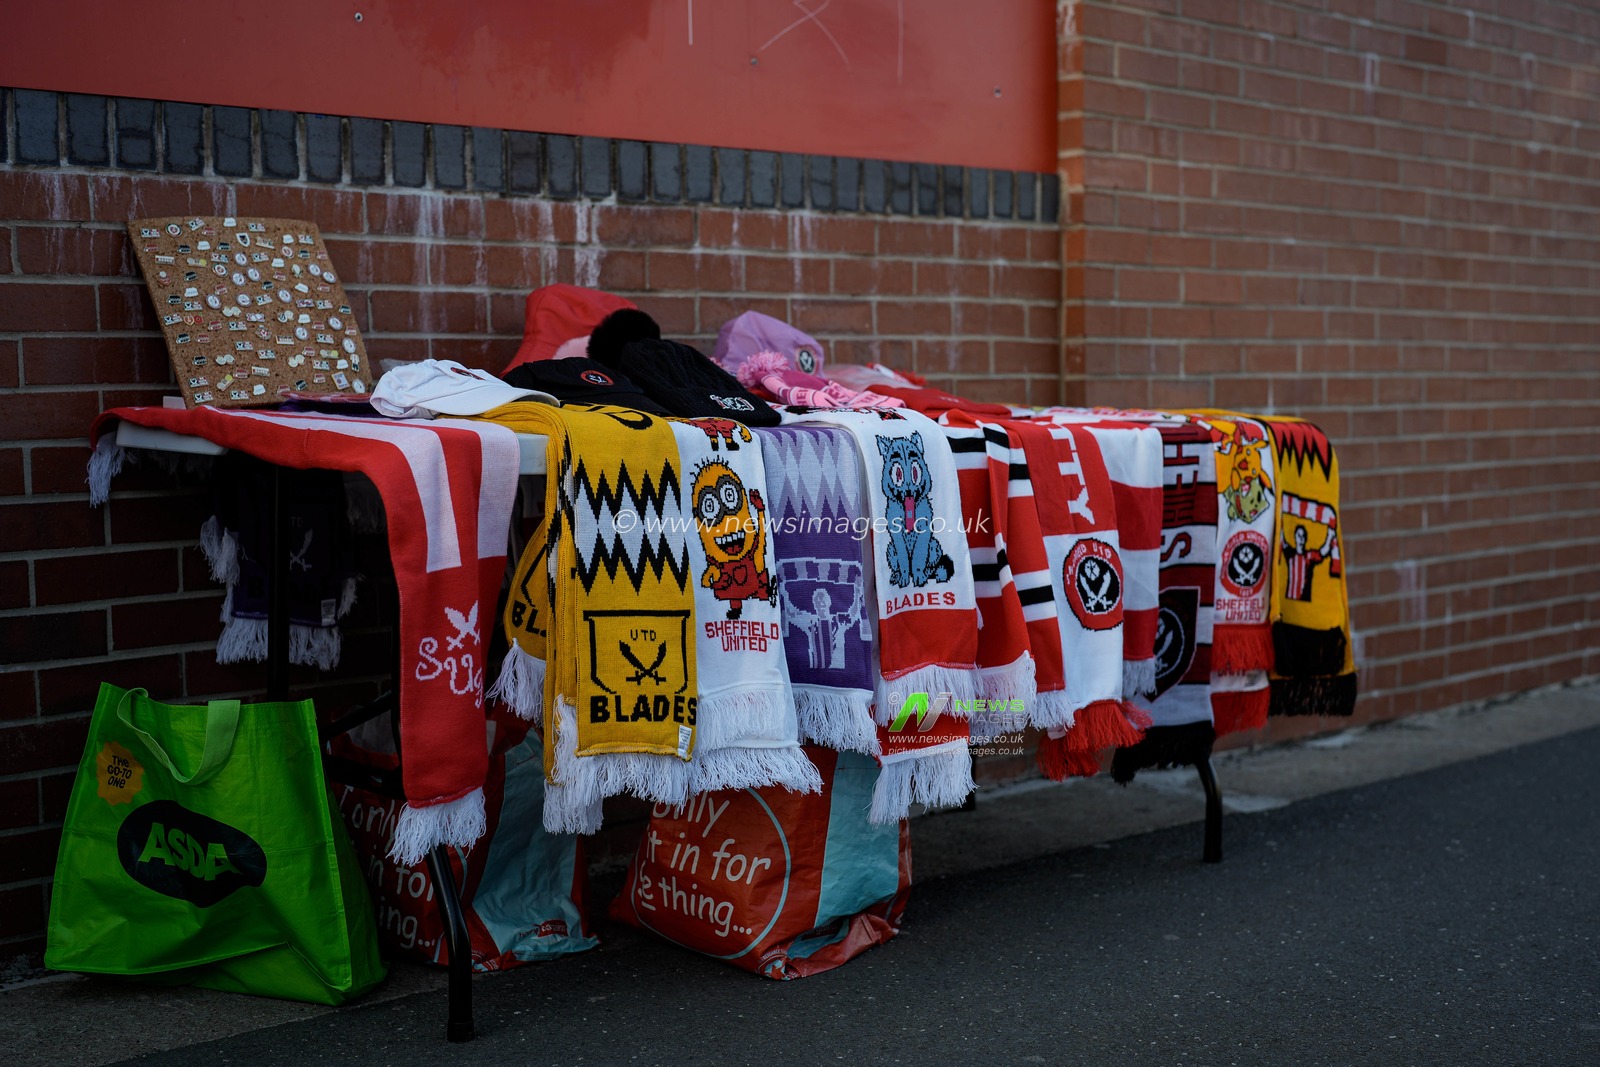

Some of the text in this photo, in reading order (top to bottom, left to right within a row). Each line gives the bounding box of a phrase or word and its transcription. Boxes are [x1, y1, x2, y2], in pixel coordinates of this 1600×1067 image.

[1092, 542, 1112, 559] UTD
[886, 592, 956, 614] BLADES
[511, 600, 547, 638] BL
[1225, 609, 1261, 621] UNITED
[630, 628, 657, 642] UTD
[704, 620, 779, 640] SHEFFIELD
[721, 635, 767, 652] UNITED
[590, 694, 697, 724] BLADES
[107, 766, 132, 779] GO-TO
[138, 822, 244, 881] ASDA
[670, 832, 700, 875] in
[711, 838, 771, 885] for
[658, 875, 753, 938] thing...
